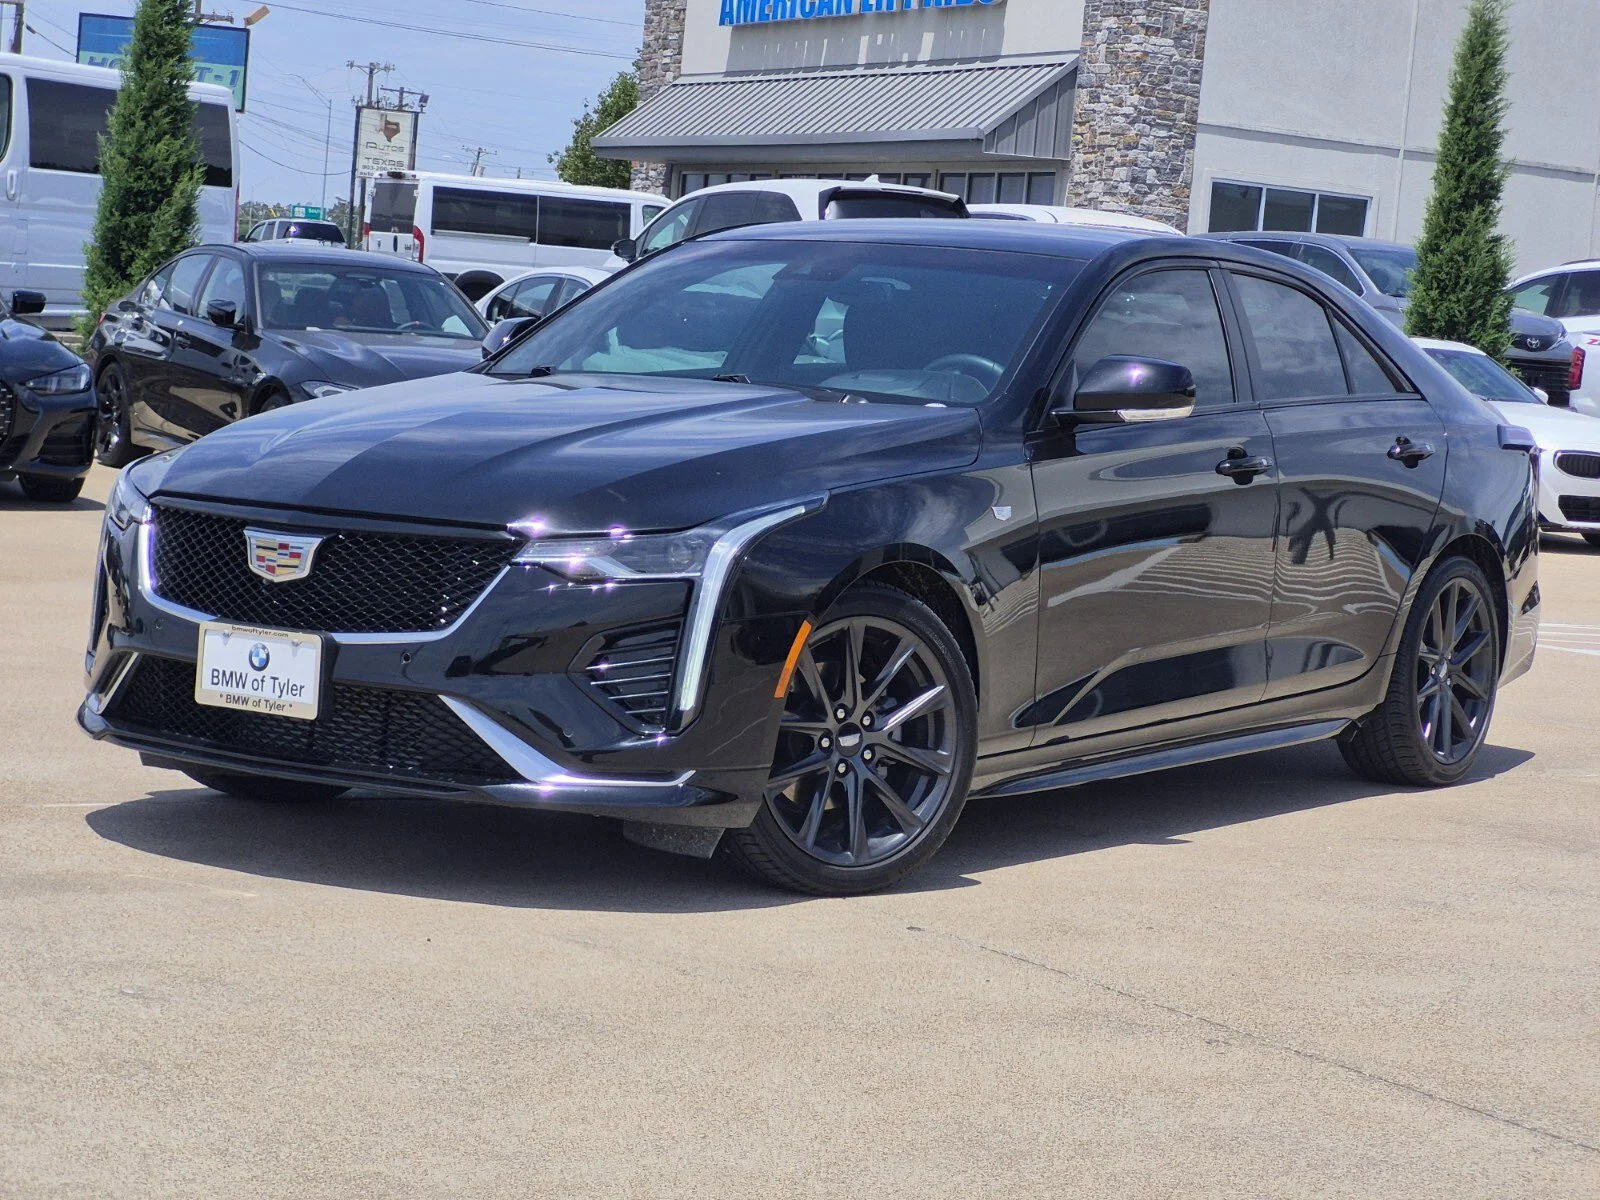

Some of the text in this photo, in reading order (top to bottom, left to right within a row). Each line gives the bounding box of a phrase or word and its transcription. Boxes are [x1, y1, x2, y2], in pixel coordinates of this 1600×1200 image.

[364, 157, 405, 168] TEXAS
[231, 625, 289, 638] bmwoftyler.com
[211, 668, 305, 698] BMW of Tyler
[225, 694, 286, 712] BMW of Tyler
